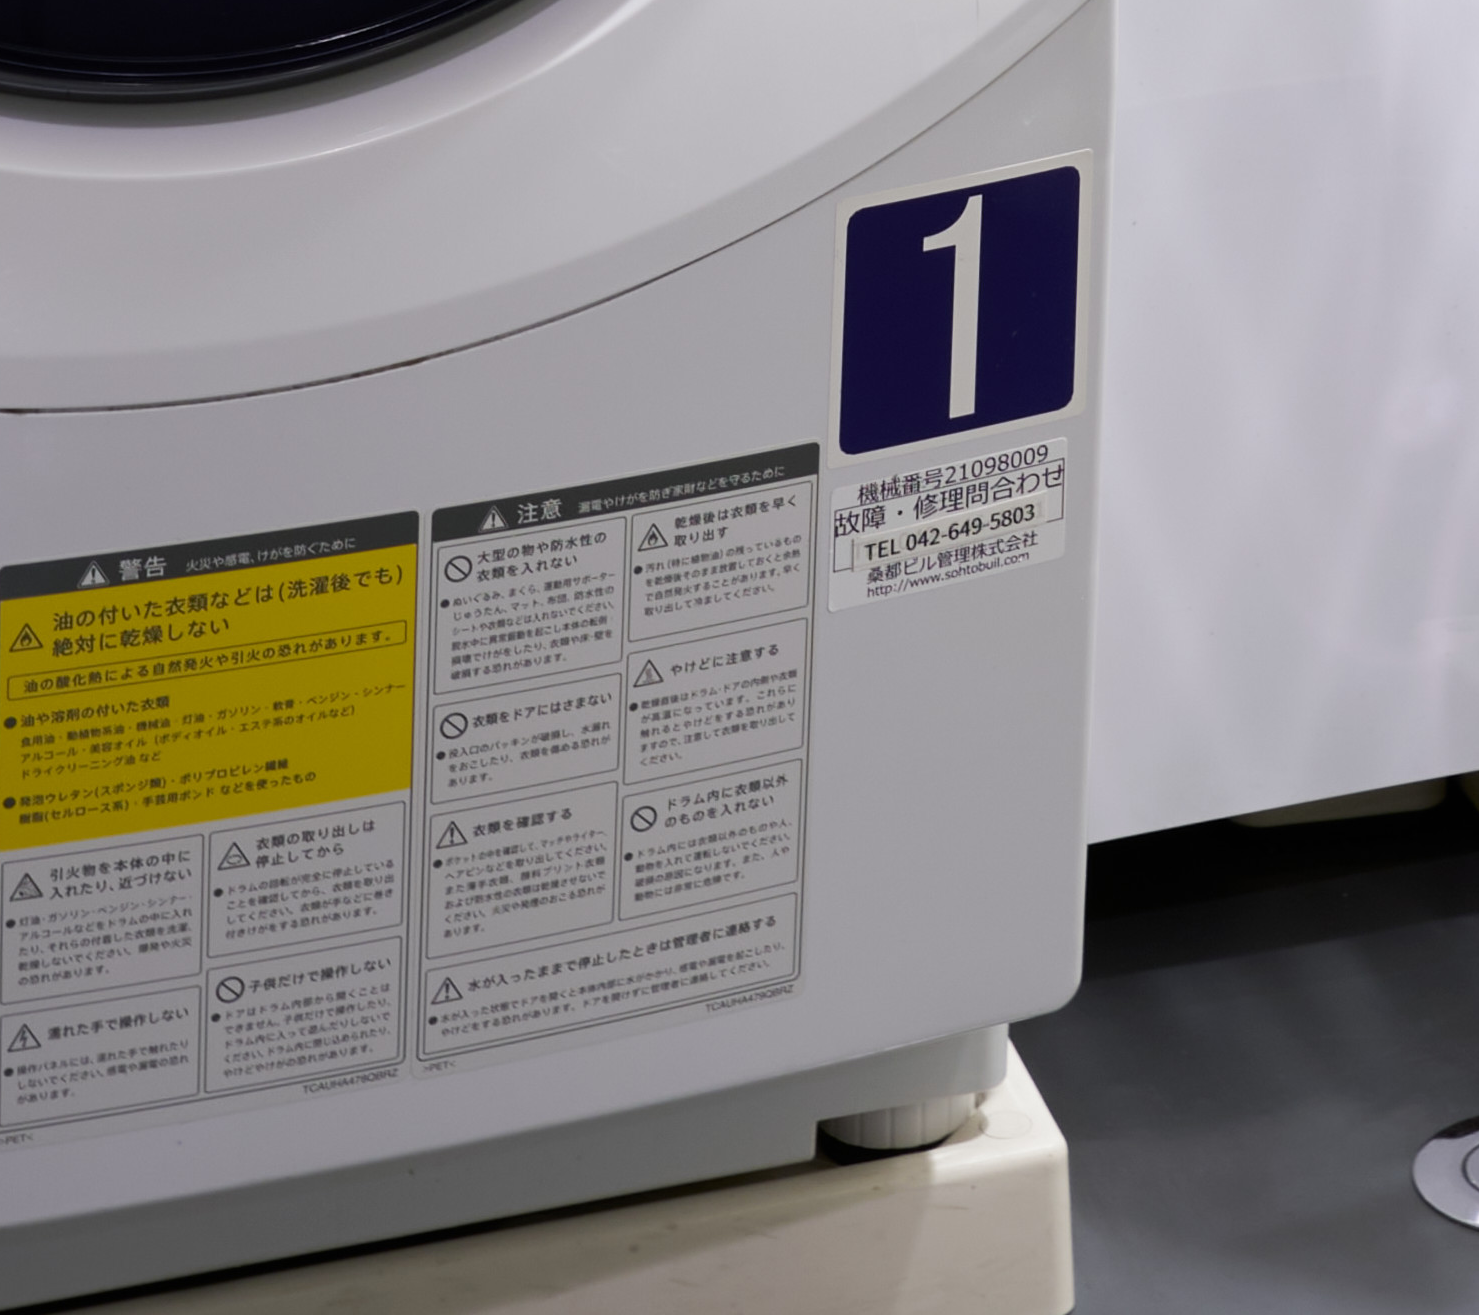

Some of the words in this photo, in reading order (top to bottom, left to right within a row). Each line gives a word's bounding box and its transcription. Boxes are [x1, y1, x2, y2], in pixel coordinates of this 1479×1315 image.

[923, 194, 982, 419] 1
[858, 445, 1048, 504] 機械番号21098009
[517, 499, 562, 524] 注意
[674, 494, 797, 529] 乾燥後は衣類を早く
[478, 532, 607, 564] 大型の物や防水性の
[865, 540, 901, 561] TEL
[906, 505, 1035, 551] 042-649-5803
[120, 556, 166, 581] 警告
[477, 554, 577, 582] 衣類を入れない
[52, 618, 230, 658] 絶対に乾燥しない
[671, 644, 780, 676] やけどに注意する
[256, 820, 376, 851] 衣類の取り出しは
[49, 850, 191, 881] 引火物を本体の中に
[249, 957, 391, 993] 子供だけで操作しない
